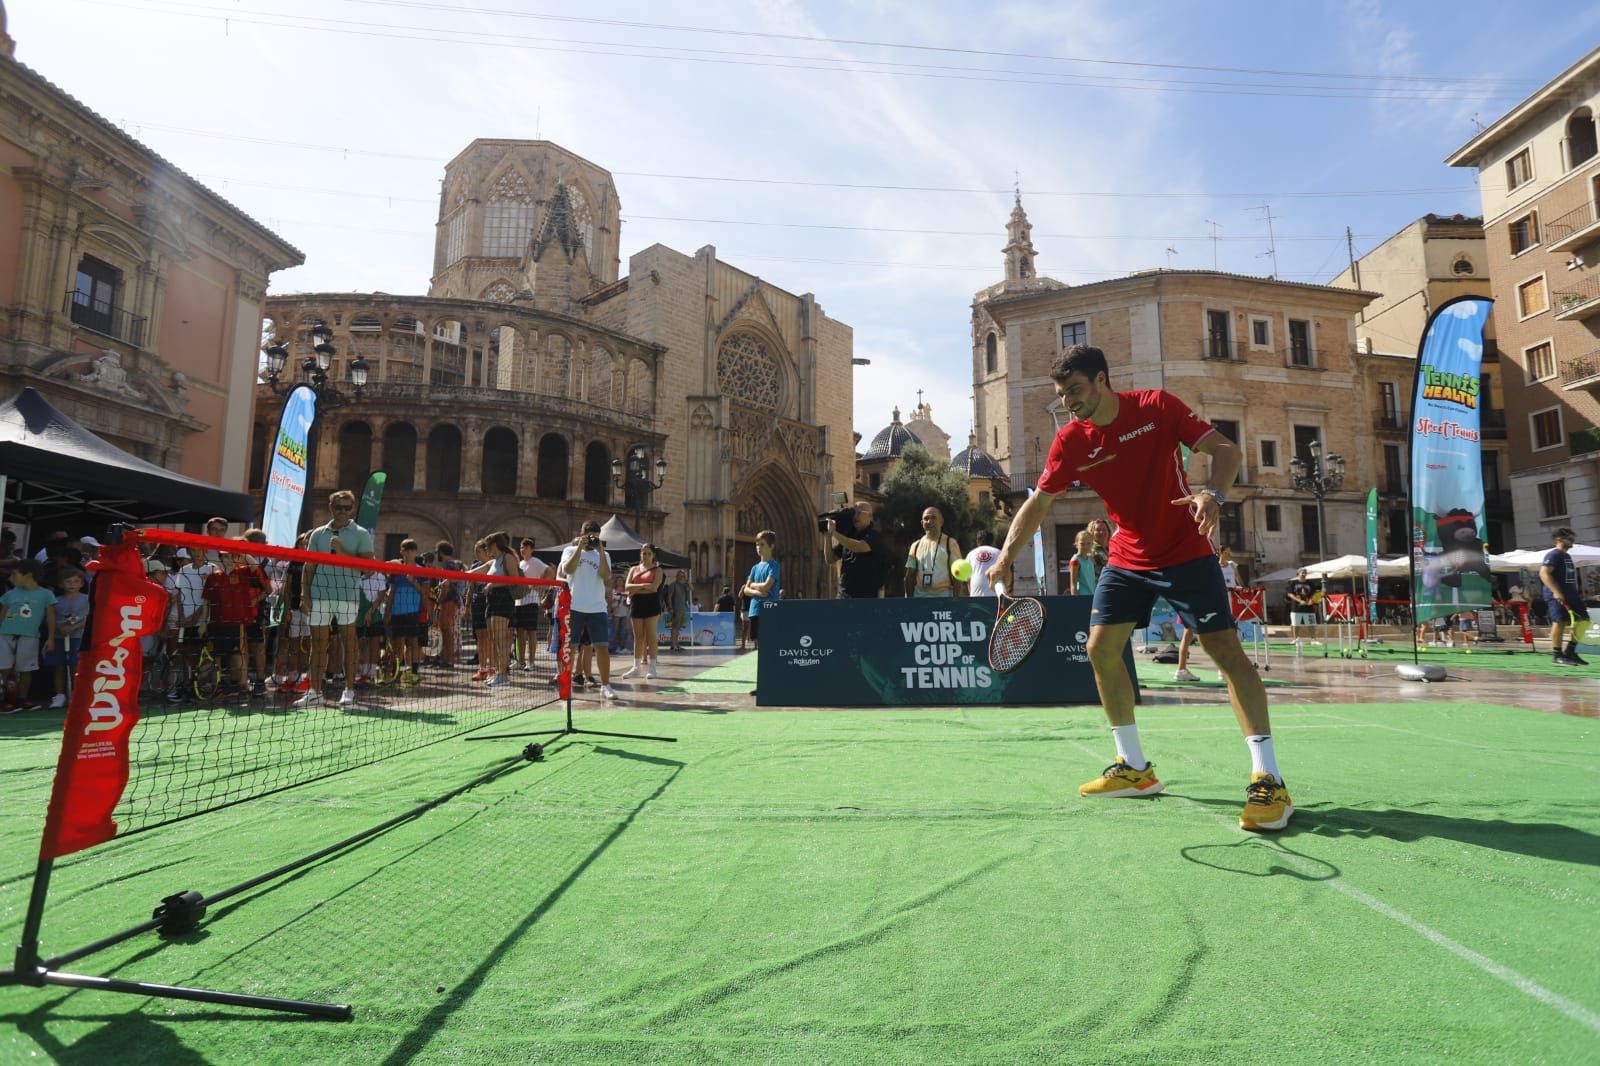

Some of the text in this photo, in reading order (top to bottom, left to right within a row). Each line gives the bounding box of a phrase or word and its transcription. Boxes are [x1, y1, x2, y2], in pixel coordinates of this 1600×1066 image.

[1419, 365, 1480, 396] TENNIS
[1423, 385, 1477, 409] HEALTH
[1119, 422, 1156, 443] MAPFRE
[1416, 418, 1480, 442] Street Tennis
[932, 611, 952, 620] THE
[900, 621, 987, 642] WORLD
[793, 658, 820, 666] Rakuten
[914, 644, 975, 665] CUP OF
[901, 666, 992, 688] TENNIS
